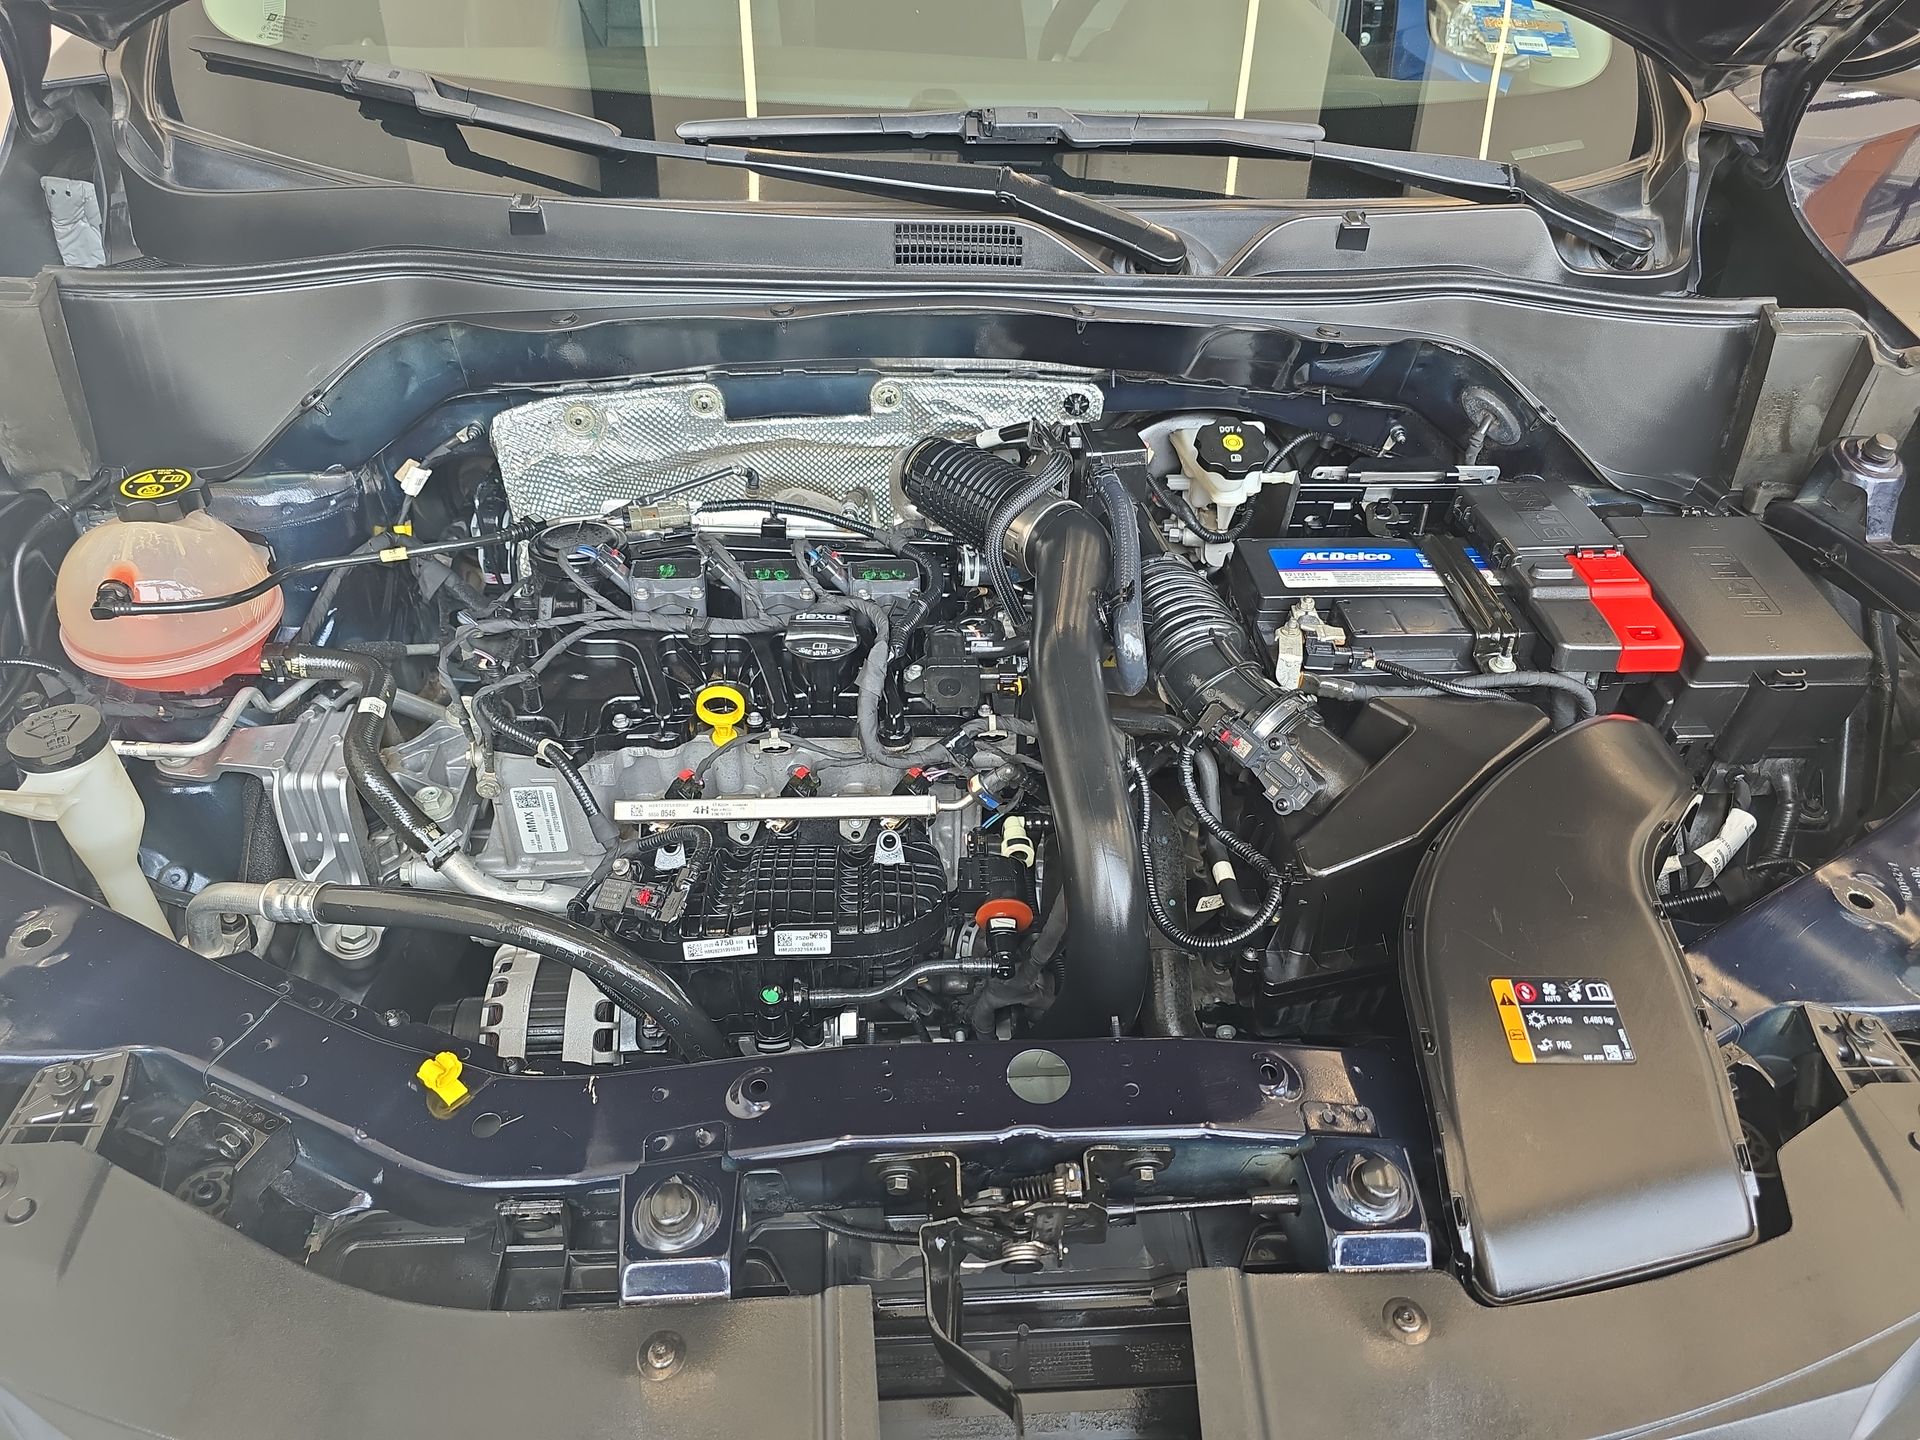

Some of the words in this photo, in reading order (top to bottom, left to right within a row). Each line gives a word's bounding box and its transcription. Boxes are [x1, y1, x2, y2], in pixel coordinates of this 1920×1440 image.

[1219, 425, 1235, 433] DOT
[1236, 425, 1242, 433] 4
[1299, 551, 1392, 562] ACDelco
[795, 612, 847, 621] dexos
[660, 809, 676, 818] 0546
[693, 805, 709, 815] 4H
[523, 810, 538, 833] MMX
[714, 939, 734, 947] 4750
[747, 938, 756, 949] H
[555, 946, 576, 961] PA
[621, 980, 650, 1001] PET
[1544, 995, 1561, 1003] AUTO
[1546, 1016, 1572, 1025] R-134a
[1604, 1016, 1614, 1025] kg
[1556, 1040, 1572, 1050] PAG
